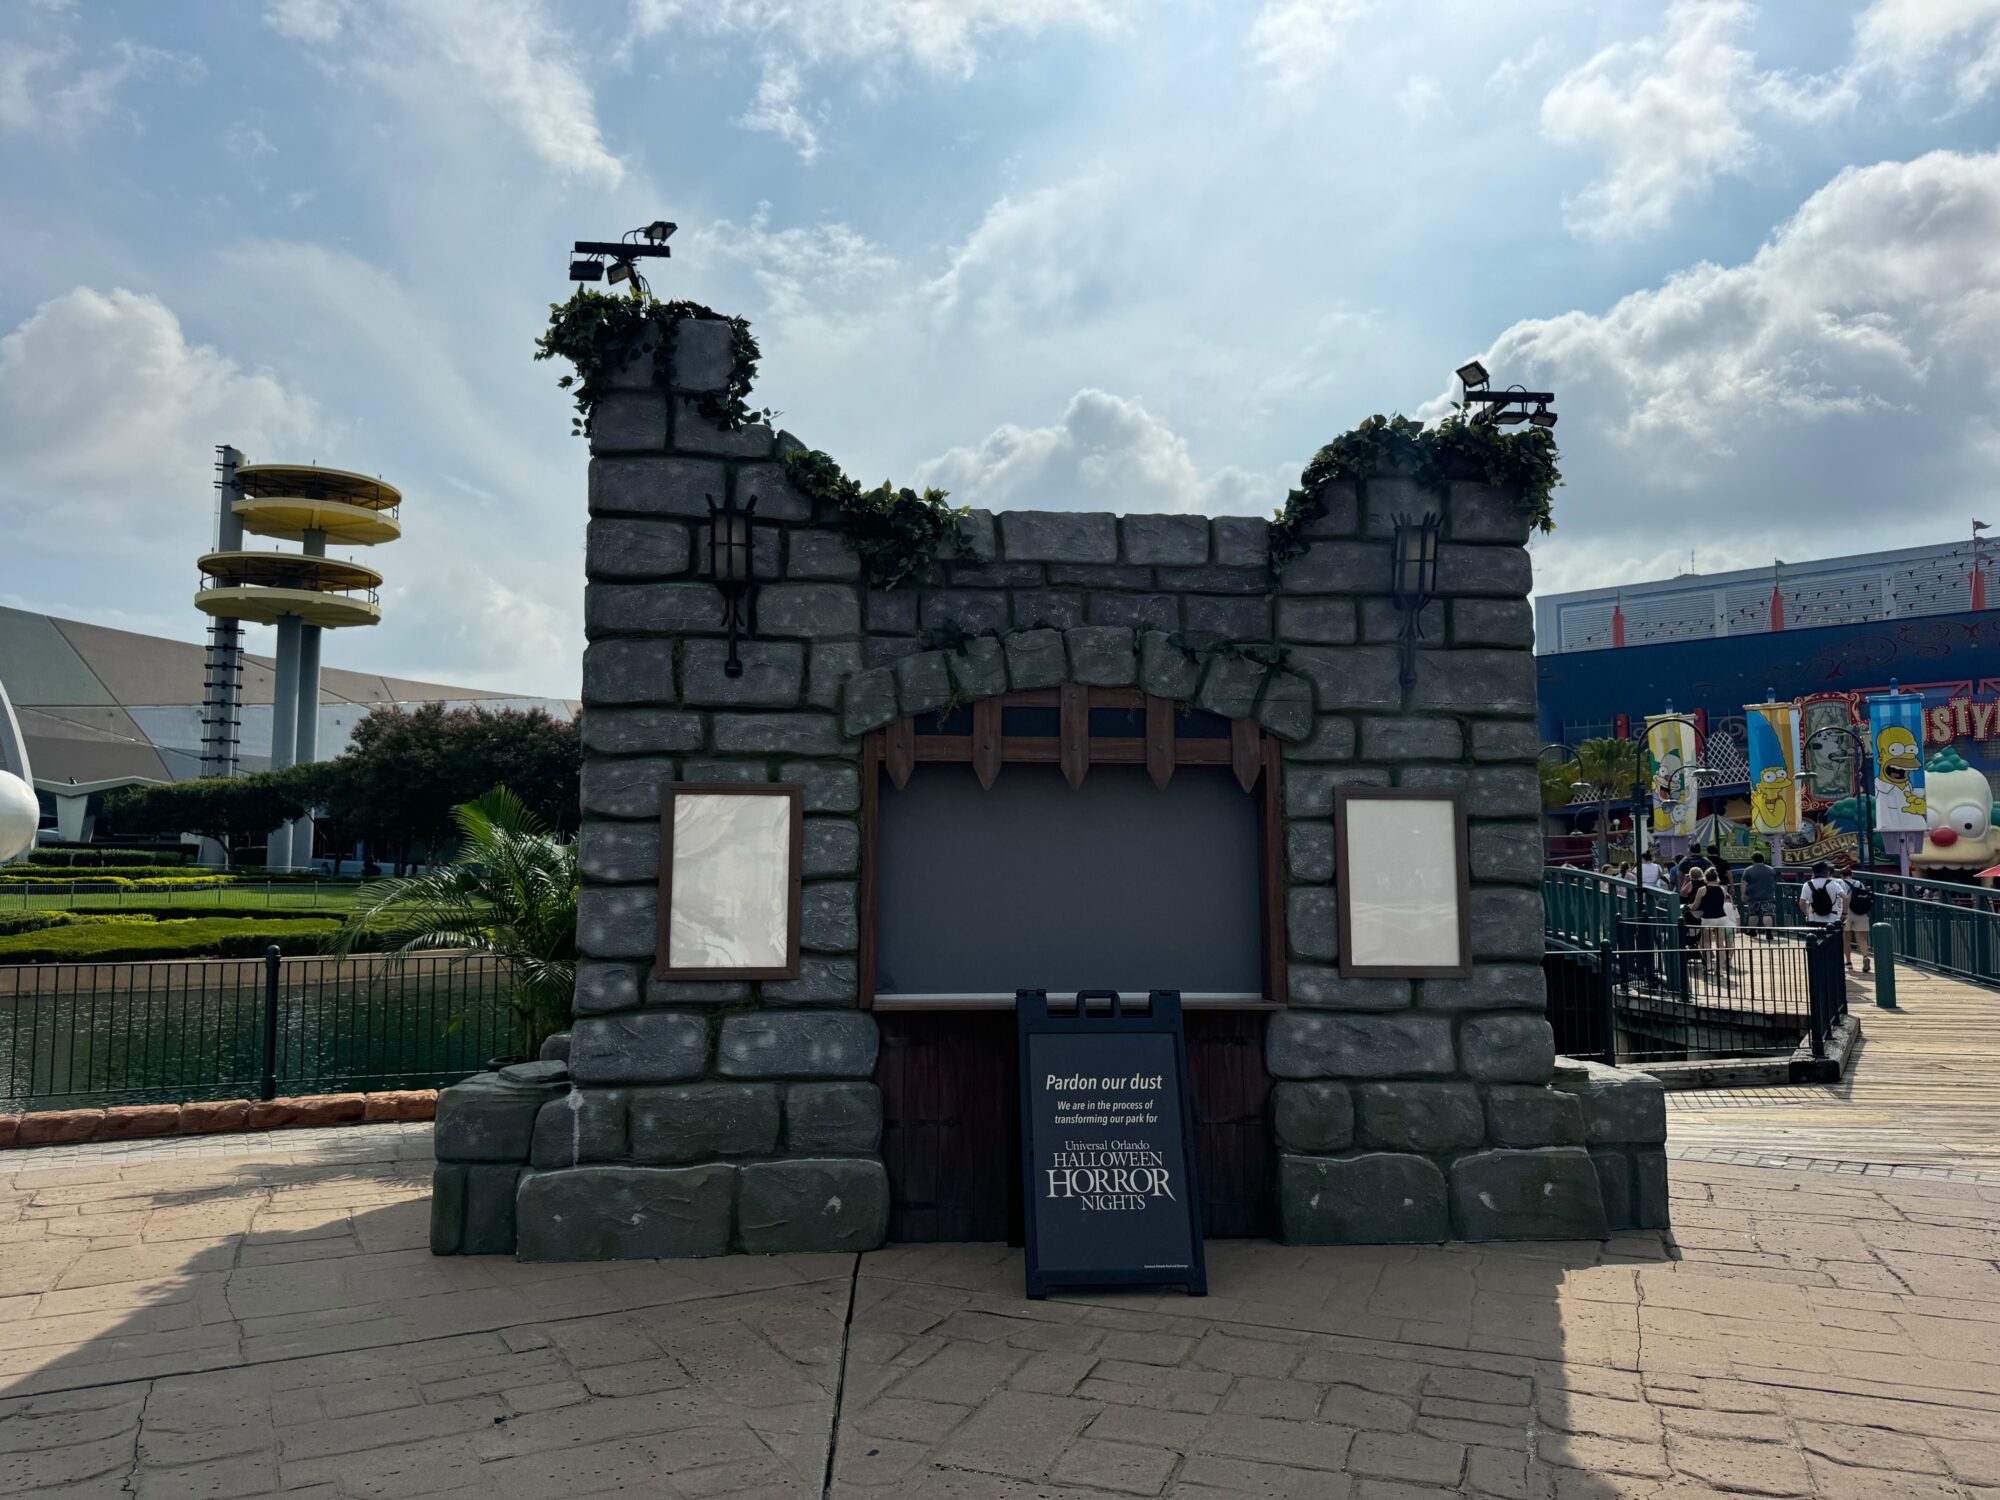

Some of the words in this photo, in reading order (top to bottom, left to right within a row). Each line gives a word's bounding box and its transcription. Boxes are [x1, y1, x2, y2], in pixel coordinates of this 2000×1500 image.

[1785, 849, 1811, 862] EYE
[1811, 833, 1858, 856] CARUM
[1046, 1073, 1097, 1090] Pardon
[1101, 1077, 1127, 1090] our
[1130, 1072, 1163, 1090] dust
[1057, 1100, 1071, 1110] We
[1072, 1102, 1085, 1110] are
[1087, 1100, 1096, 1110] in
[1097, 1100, 1111, 1110] the
[1112, 1101, 1143, 1112] process
[1144, 1099, 1154, 1110] of
[1054, 1113, 1108, 1126] transforming
[1109, 1115, 1125, 1124] our
[1125, 1113, 1144, 1126] park
[1146, 1112, 1158, 1123] for
[1065, 1140, 1108, 1151] Universal
[1110, 1139, 1150, 1151] Orlando
[1053, 1151, 1163, 1168] HALLOWEEN
[1045, 1167, 1177, 1202] HORROR
[1080, 1194, 1146, 1211] NIGHTS
